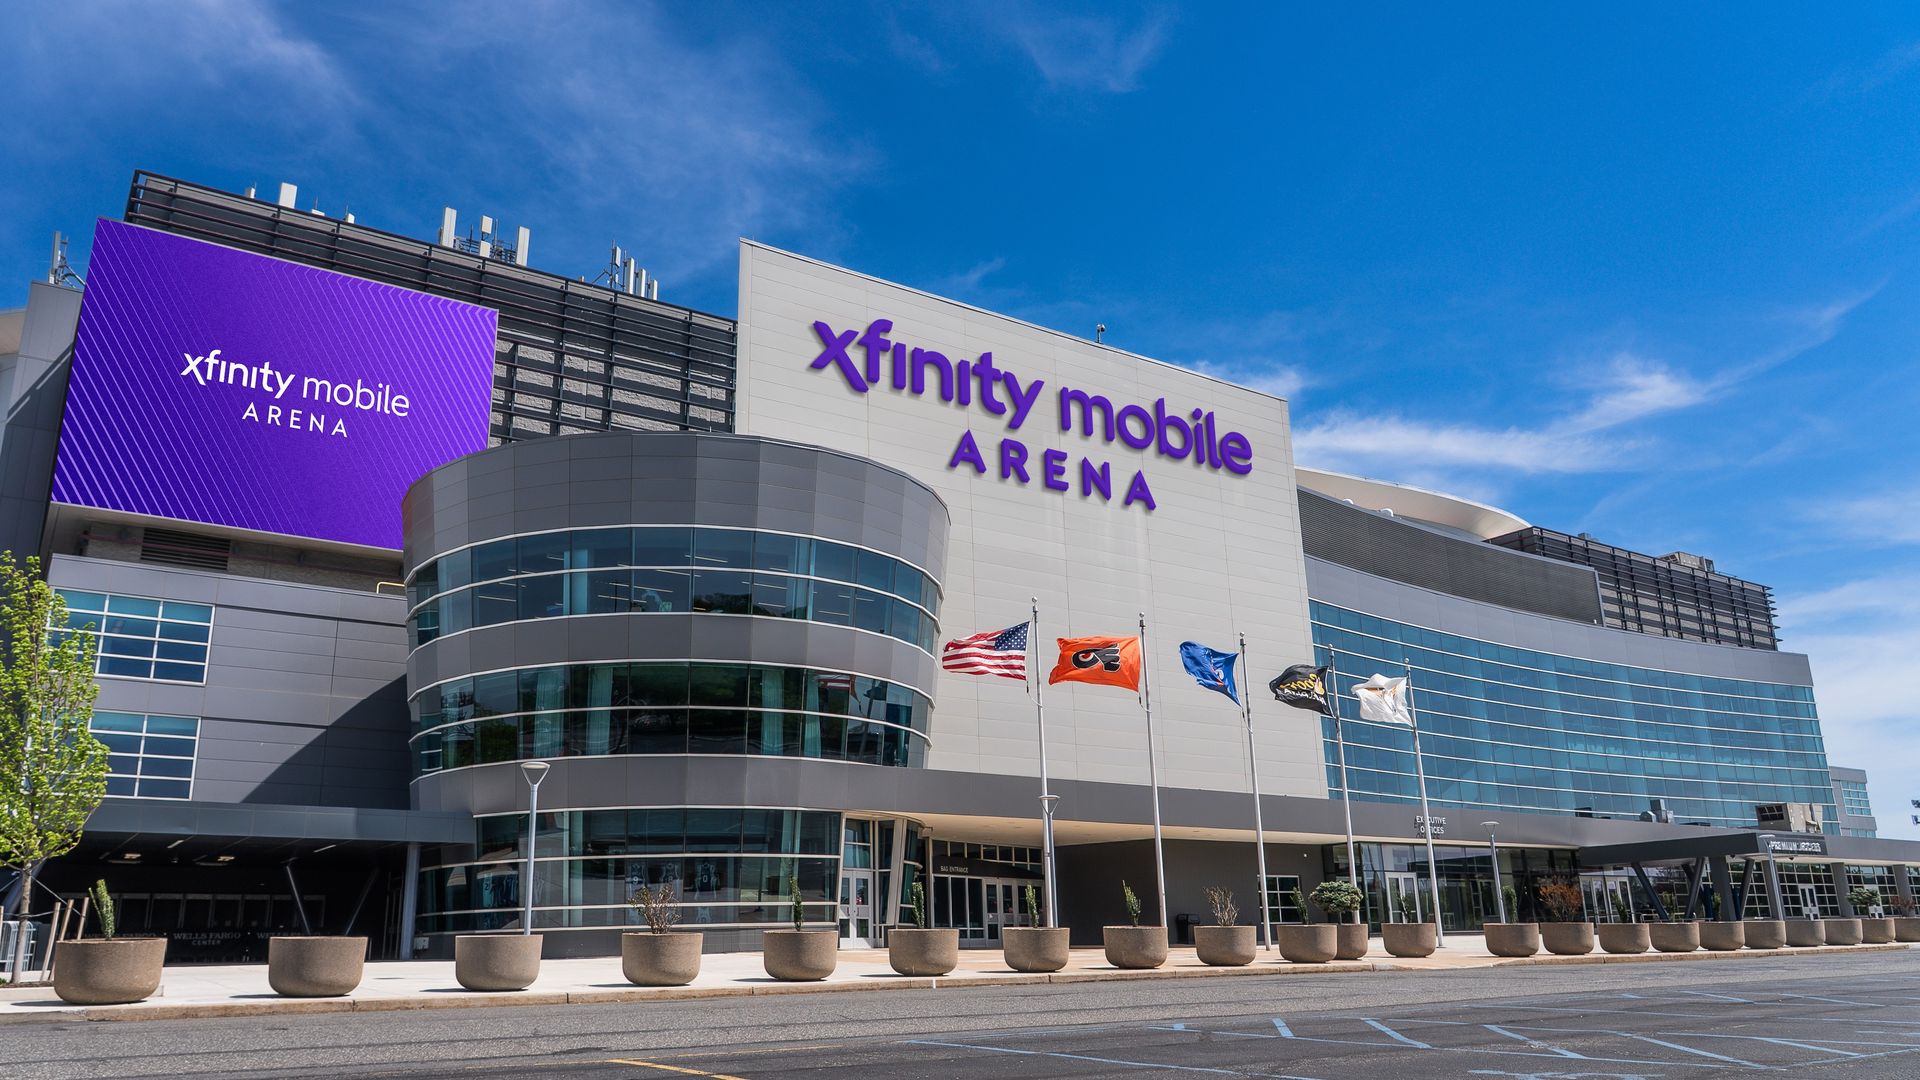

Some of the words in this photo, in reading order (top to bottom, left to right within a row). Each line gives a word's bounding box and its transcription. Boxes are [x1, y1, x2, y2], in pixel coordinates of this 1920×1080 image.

[180, 349, 295, 399] xfinity
[302, 379, 410, 417] mobile
[810, 318, 1044, 429] xfinity
[1060, 386, 1253, 475] mobile
[241, 402, 348, 437] ARENA
[949, 429, 1156, 511] ARENA
[1415, 815, 1447, 825] EXUTIVE
[1420, 825, 1445, 834] OICES
[173, 932, 209, 940] WELLS
[209, 931, 242, 940] FARGO
